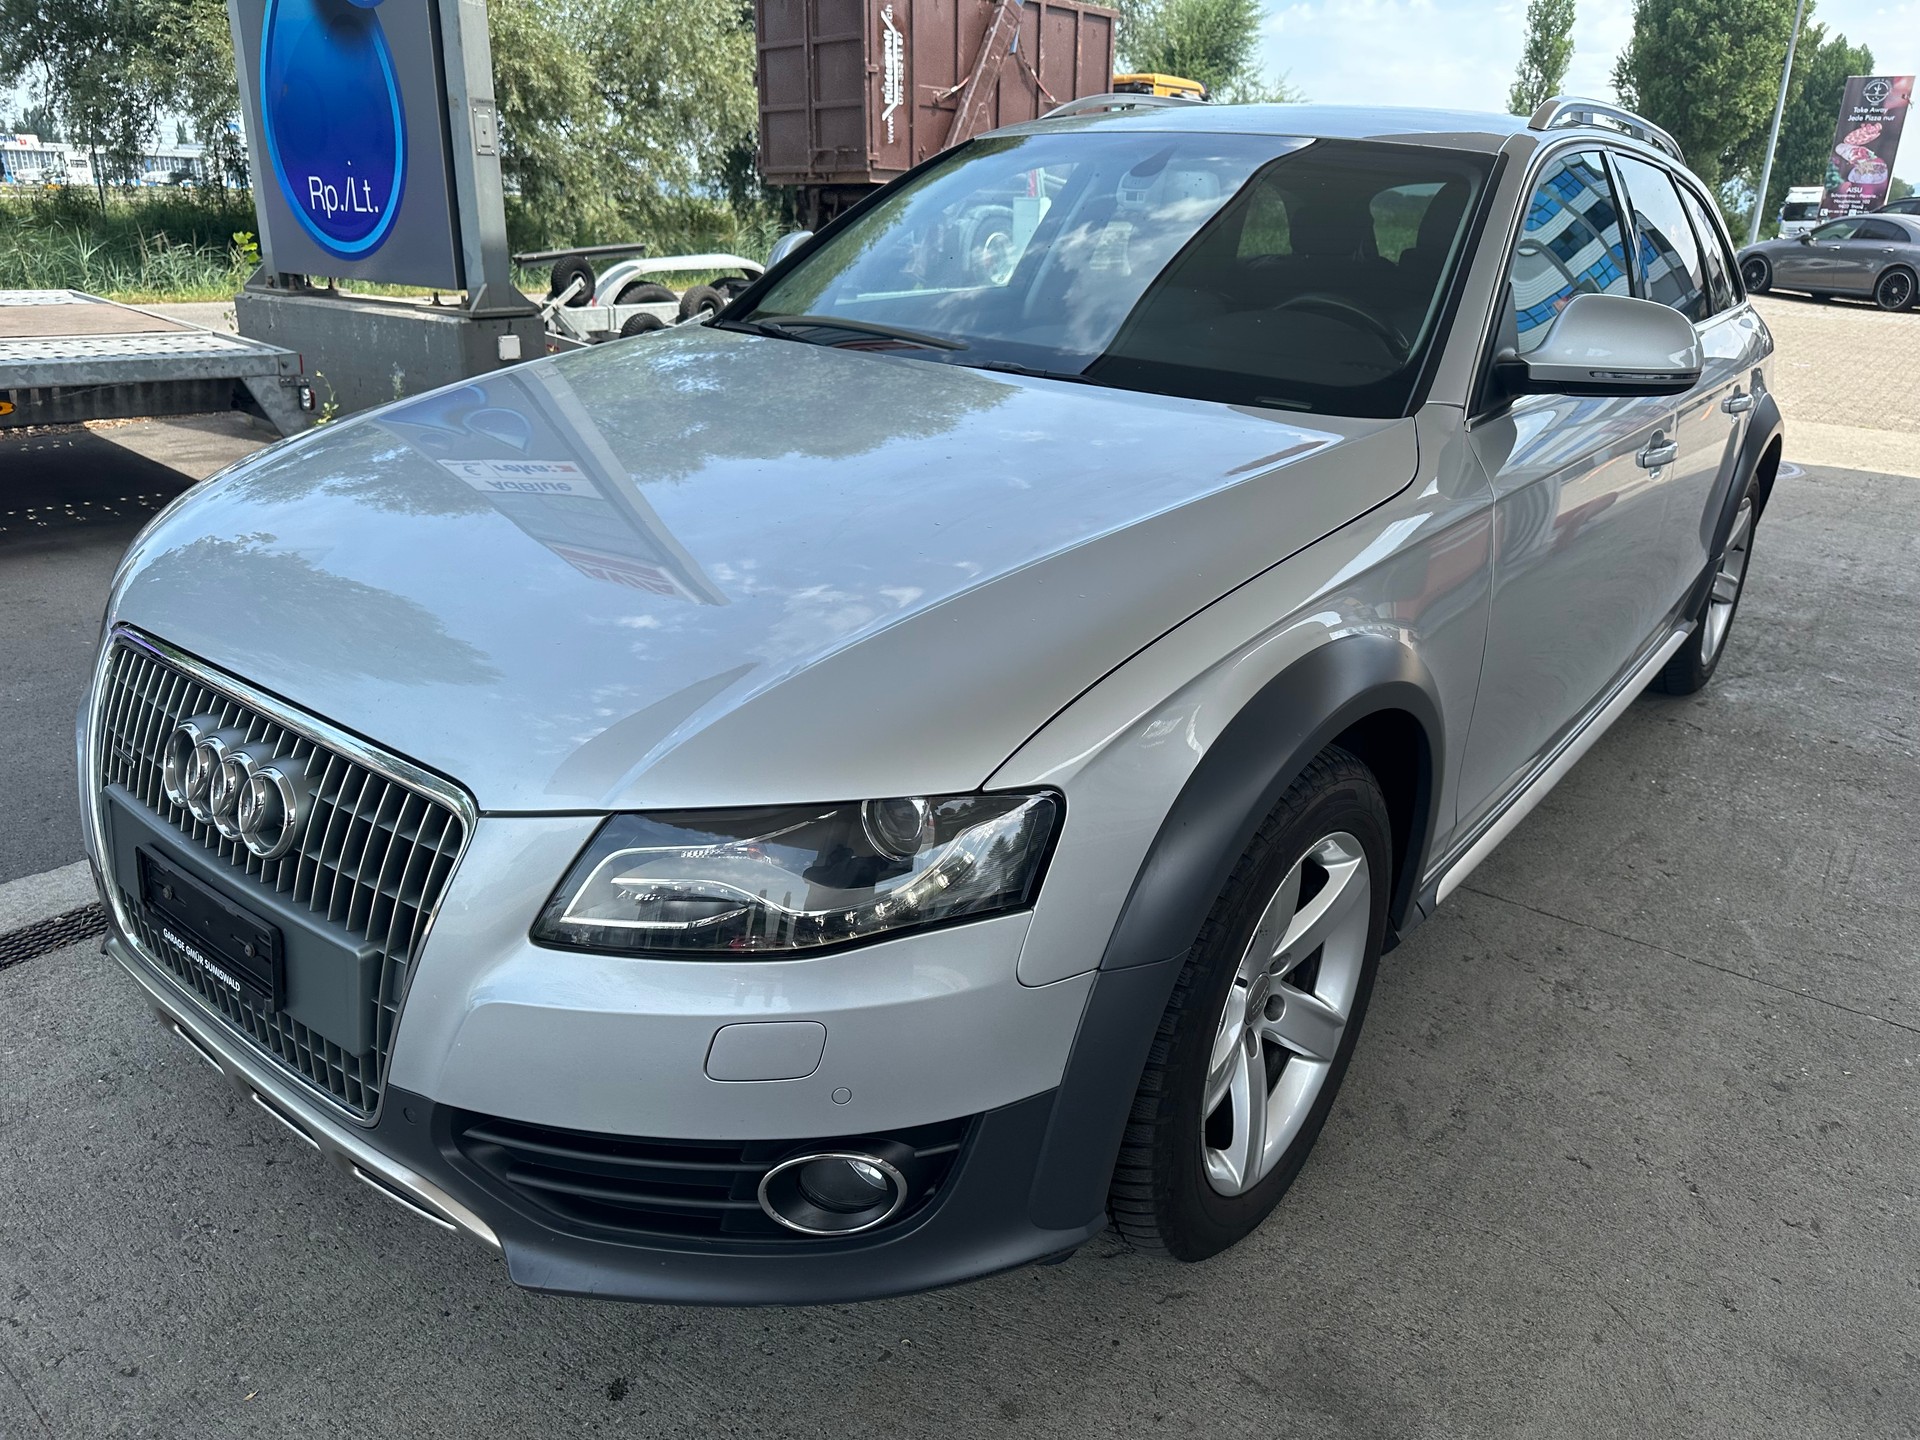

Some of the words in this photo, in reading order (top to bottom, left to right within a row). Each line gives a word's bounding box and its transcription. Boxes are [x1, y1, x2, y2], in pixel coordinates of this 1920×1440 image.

[1853, 106, 1868, 114] Take
[1864, 114, 1882, 122] Pizza
[308, 175, 379, 219] Rp./Lt.
[163, 927, 186, 952] GARAGE
[185, 945, 204, 966] GMÜR
